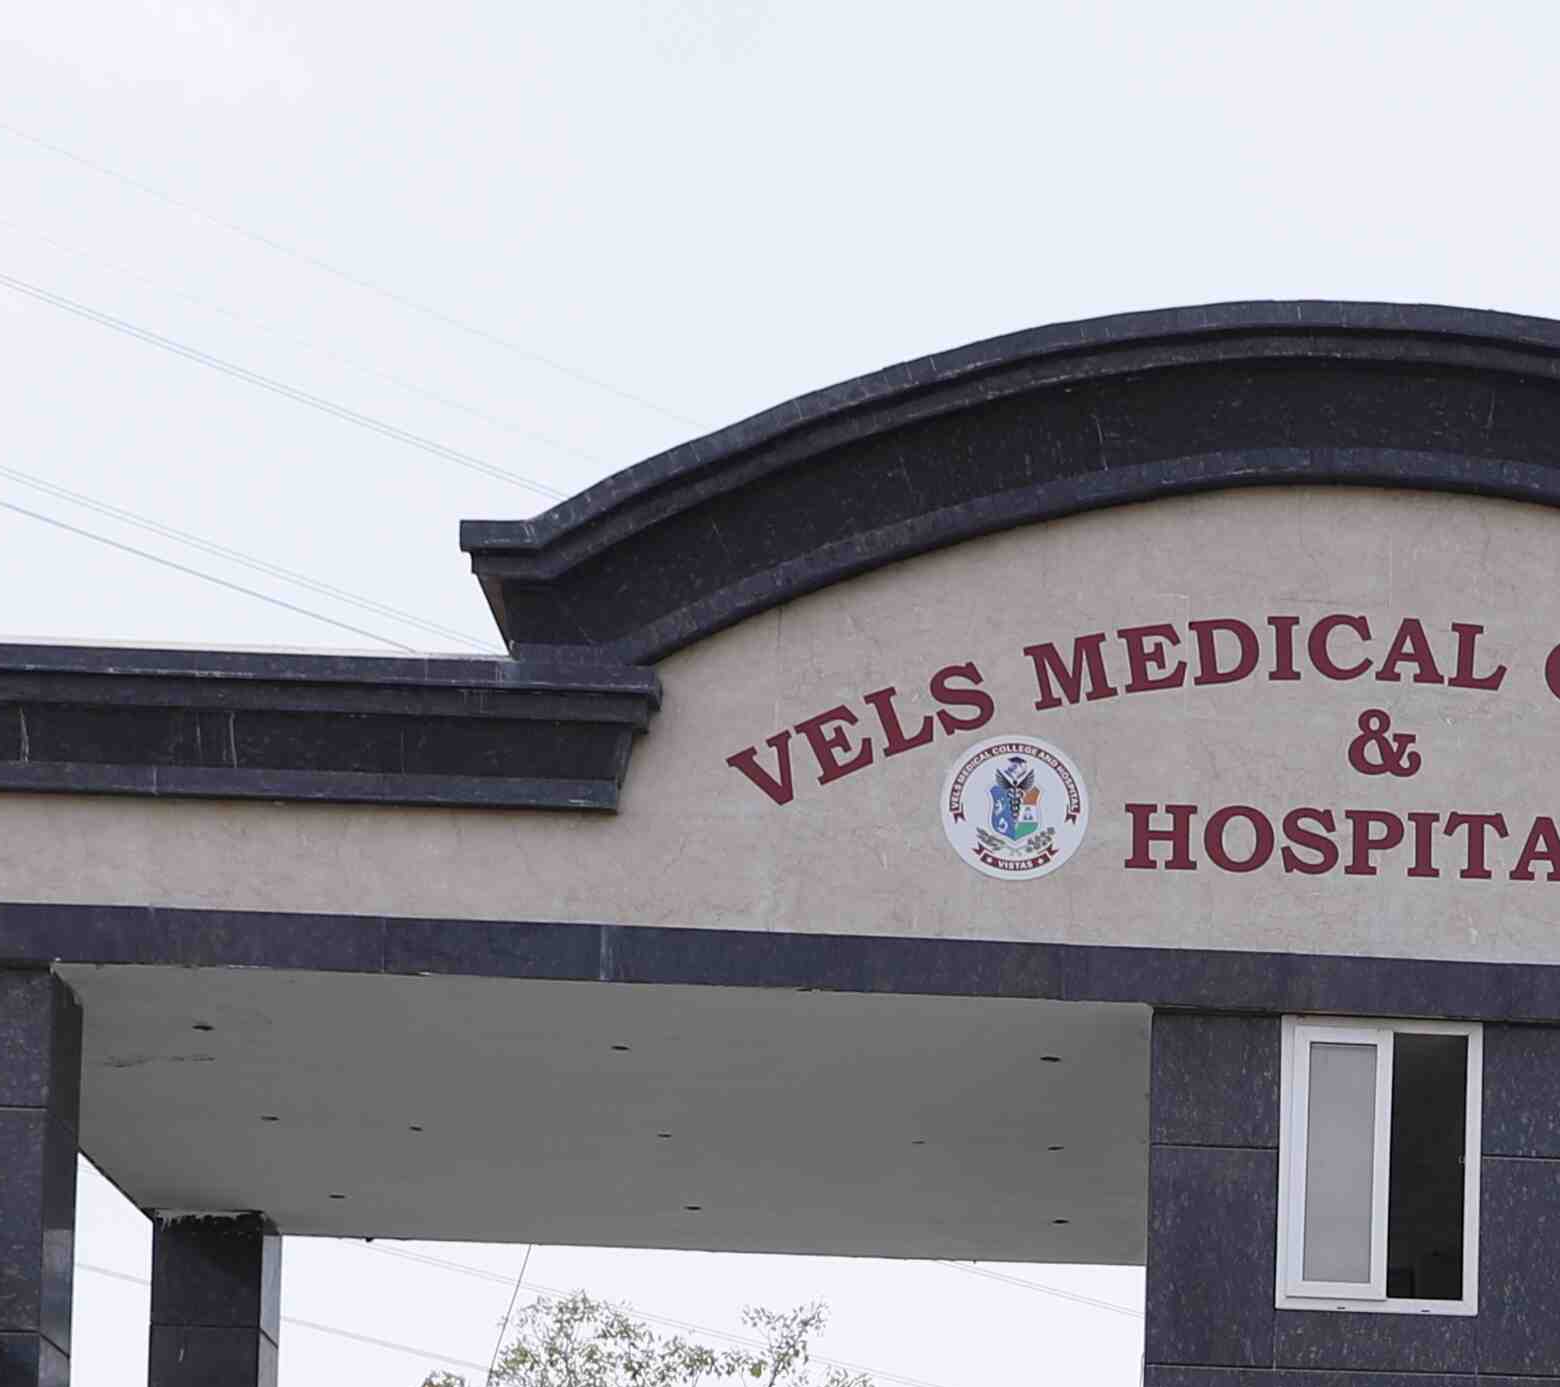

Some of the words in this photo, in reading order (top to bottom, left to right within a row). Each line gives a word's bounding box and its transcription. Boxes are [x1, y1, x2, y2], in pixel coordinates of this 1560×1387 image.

[727, 663, 994, 804] VELS
[1024, 613, 1507, 711] MEDICAL
[1350, 708, 1422, 776] &
[951, 782, 963, 809] VELS
[957, 749, 992, 784] MEDICAL
[992, 744, 1038, 757] COLLEGE
[1037, 751, 1059, 768] AND
[1057, 766, 1080, 811] HOSPITAL
[998, 859, 1034, 871] VISTAS
